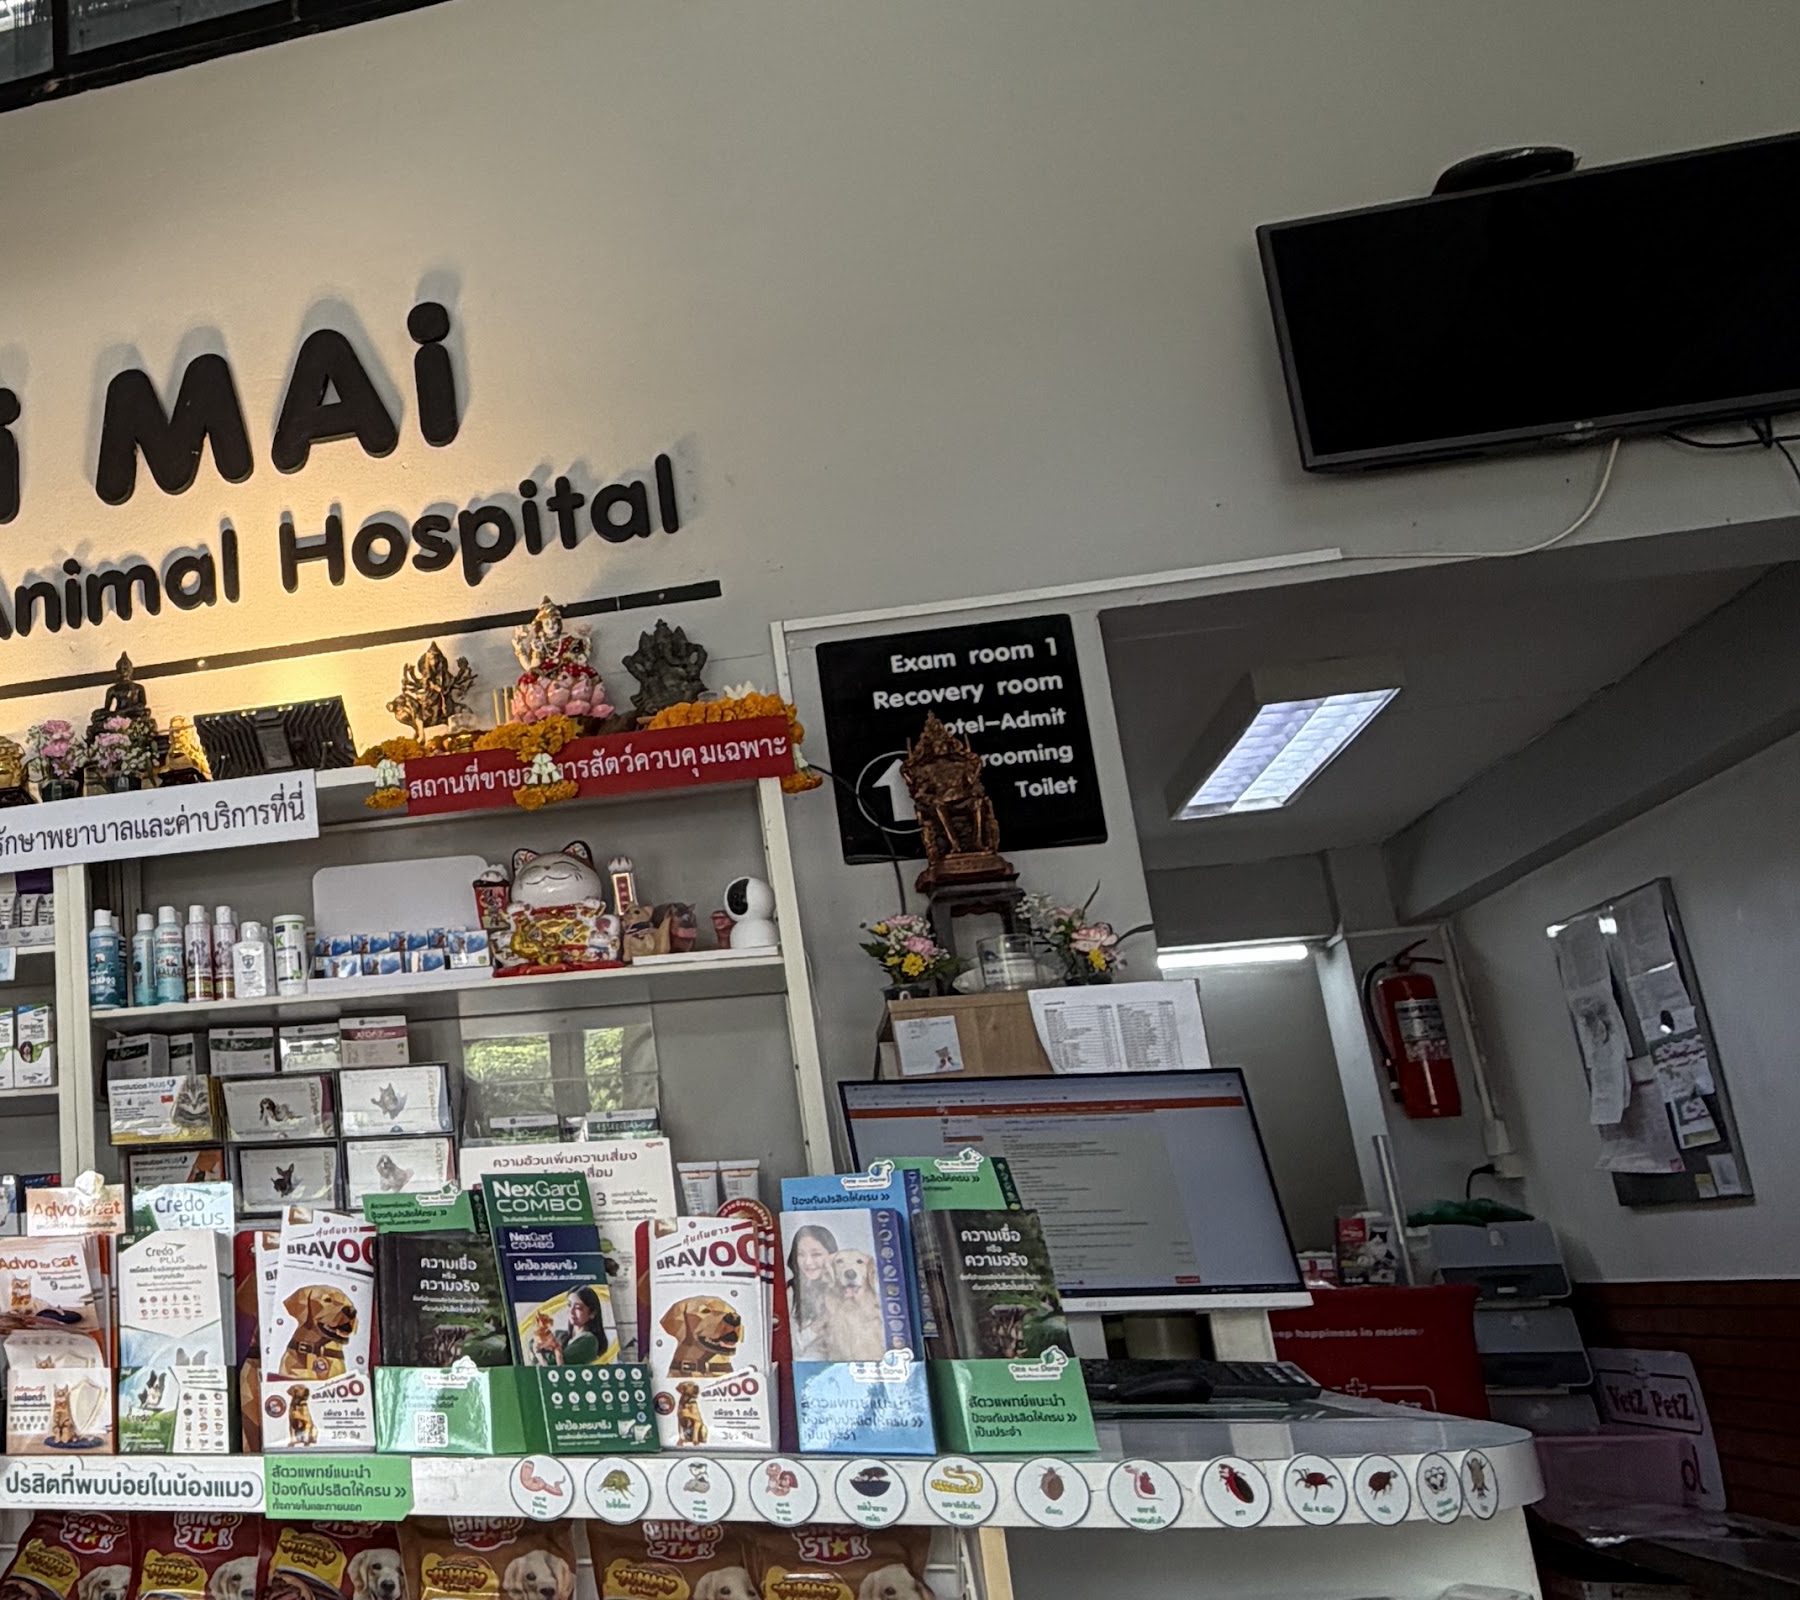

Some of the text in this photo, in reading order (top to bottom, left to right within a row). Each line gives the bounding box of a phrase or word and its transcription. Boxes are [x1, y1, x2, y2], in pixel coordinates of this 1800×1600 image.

[278, 454, 681, 592] Hospital
[890, 637, 1058, 674] Exam room 1
[872, 674, 1063, 710] Recovery room
[944, 708, 1066, 735] otel-Admit
[982, 744, 1073, 768] rooming
[1015, 776, 1078, 798] Toilet
[493, 1179, 577, 1197] NexGard
[34, 1202, 78, 1217] Advo
[155, 1194, 205, 1213] Credo
[496, 1200, 583, 1213] COMBO
[179, 1213, 225, 1227] PLUS
[509, 1232, 553, 1242] NexGard
[961, 1225, 1021, 1244] ความเชื่อ
[146, 1244, 174, 1257] Credo
[510, 1241, 555, 1250] COMBO
[52, 1254, 78, 1268] Cat
[160, 1256, 185, 1264] PLUS
[420, 1255, 478, 1271] ความเชื่อ
[964, 1251, 1029, 1269] ความจริง
[690, 1268, 716, 1278] 365
[420, 1277, 480, 1294] ความจริง
[969, 1394, 1065, 1409] สัตวแพทย์แนะนำ
[1606, 1384, 1695, 1421] VetZ PetZ
[971, 1411, 1065, 1424] ป้องกันปรสิตให้ครบ
[975, 1425, 1022, 1438] เป็นประจำ
[271, 1465, 371, 1479] สัตวแพทย์แนะนำ
[5, 1465, 254, 1498] ปรสิตที่พบบ่อยในน้องแมว
[271, 1481, 391, 1499] ป้องกันปรสิตให้ครบ
